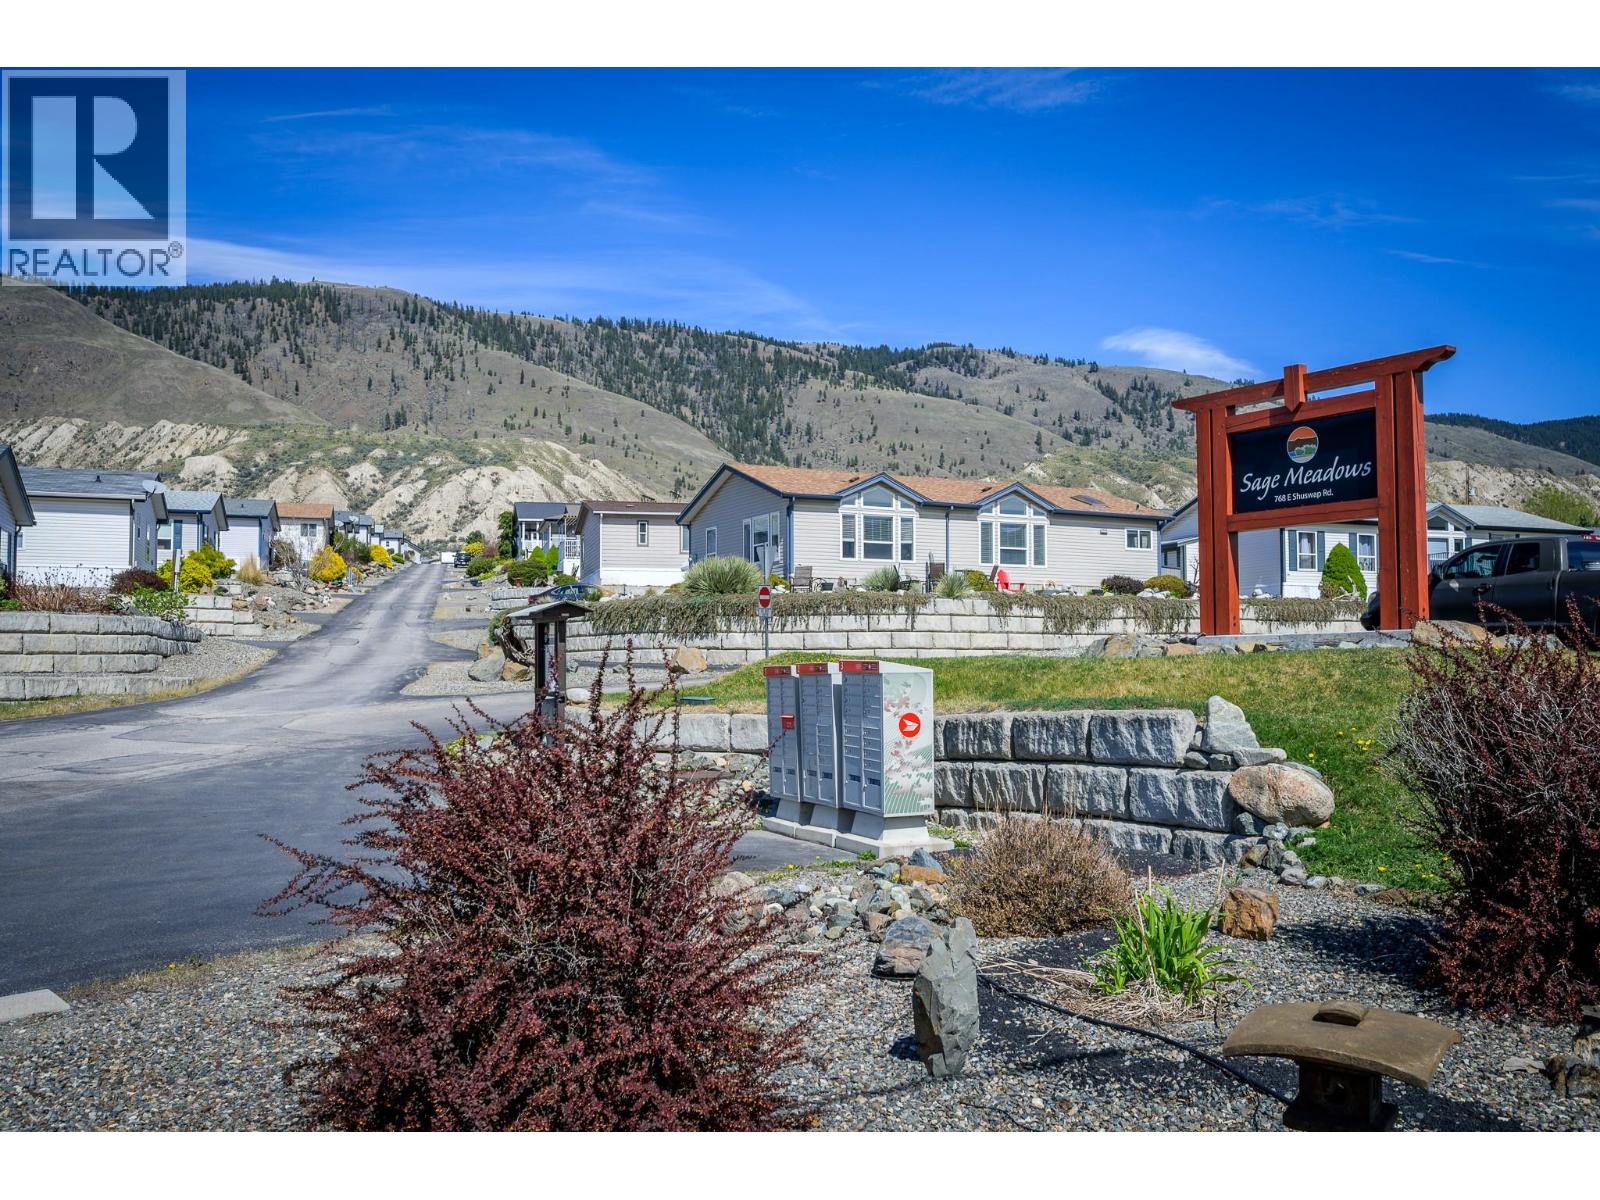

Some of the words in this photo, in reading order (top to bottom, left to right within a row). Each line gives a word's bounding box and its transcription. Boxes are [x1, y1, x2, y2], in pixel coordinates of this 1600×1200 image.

[1239, 473, 1280, 501] Sage
[1284, 455, 1372, 487] Meadows
[1274, 494, 1287, 503] 768
[1287, 493, 1292, 501] E
[1292, 491, 1322, 501] Shuswap
[1322, 488, 1334, 497] Rd.
